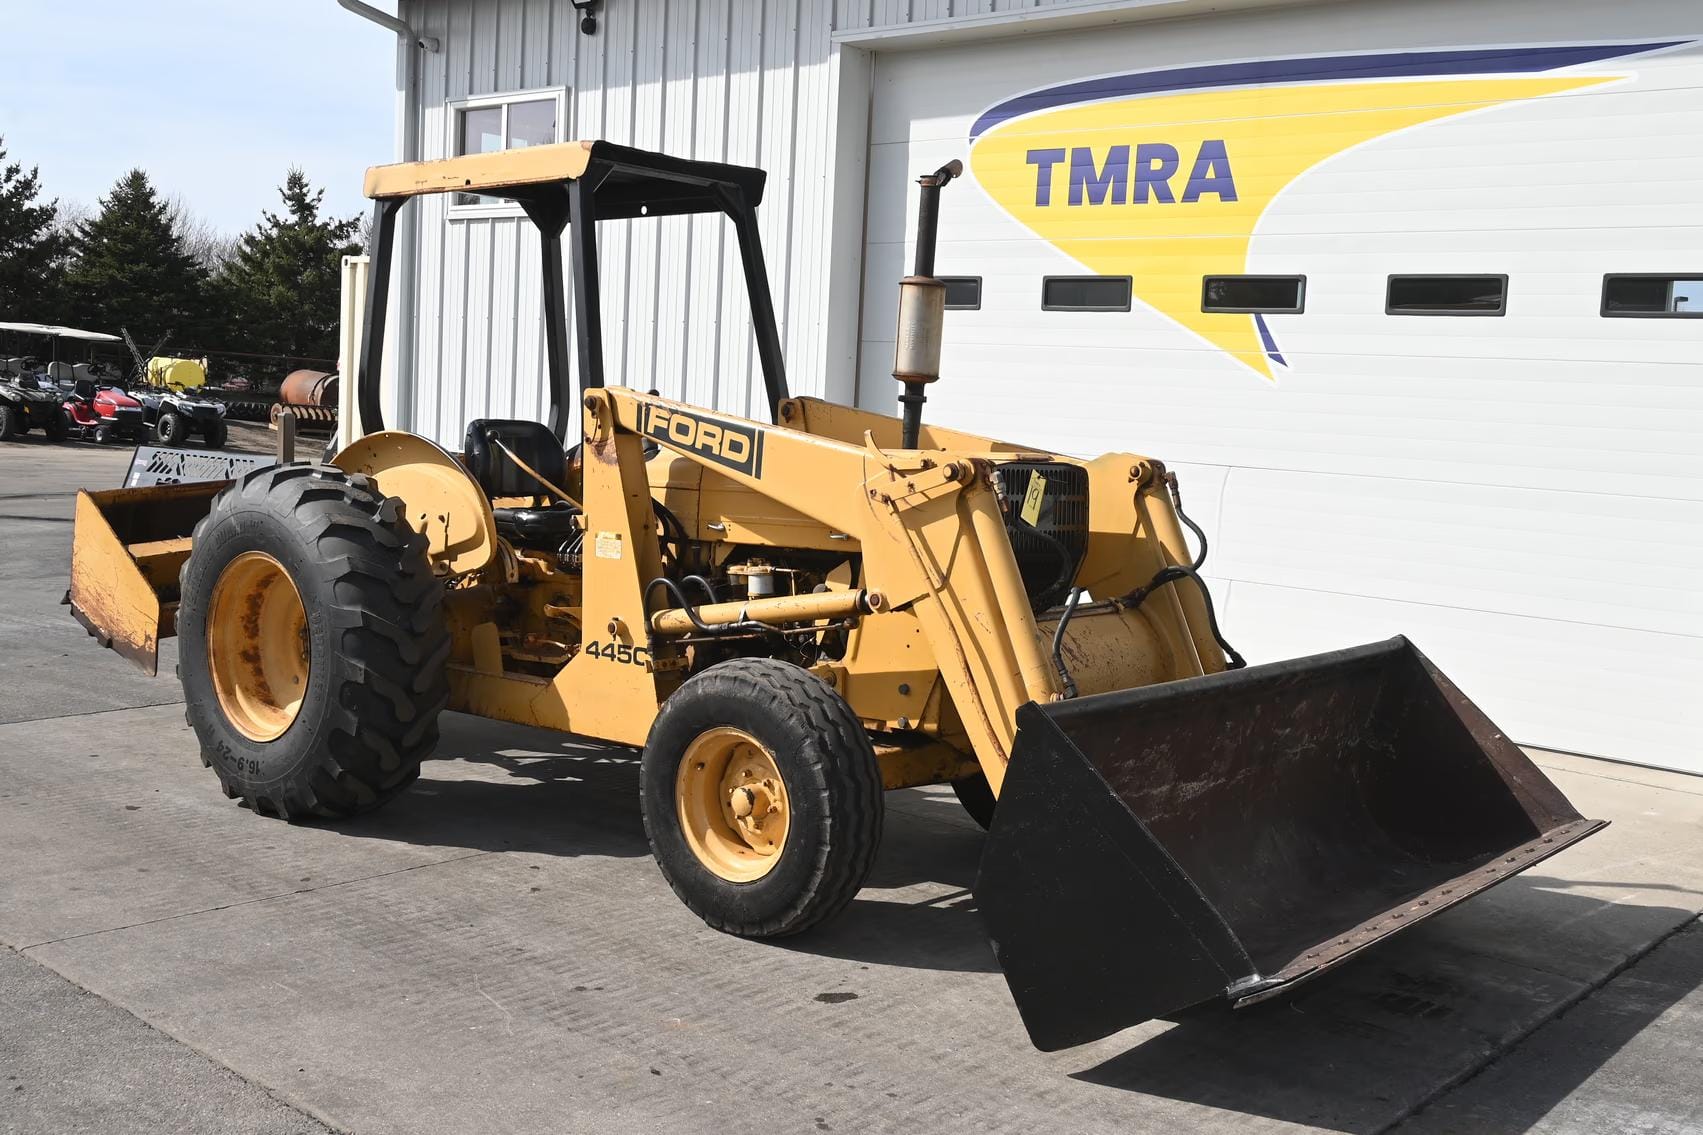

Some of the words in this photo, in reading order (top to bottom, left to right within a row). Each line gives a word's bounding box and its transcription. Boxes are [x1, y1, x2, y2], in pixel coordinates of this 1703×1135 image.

[1026, 140, 1239, 207] TMRA
[647, 405, 751, 464] FORD
[585, 640, 649, 666] 445C
